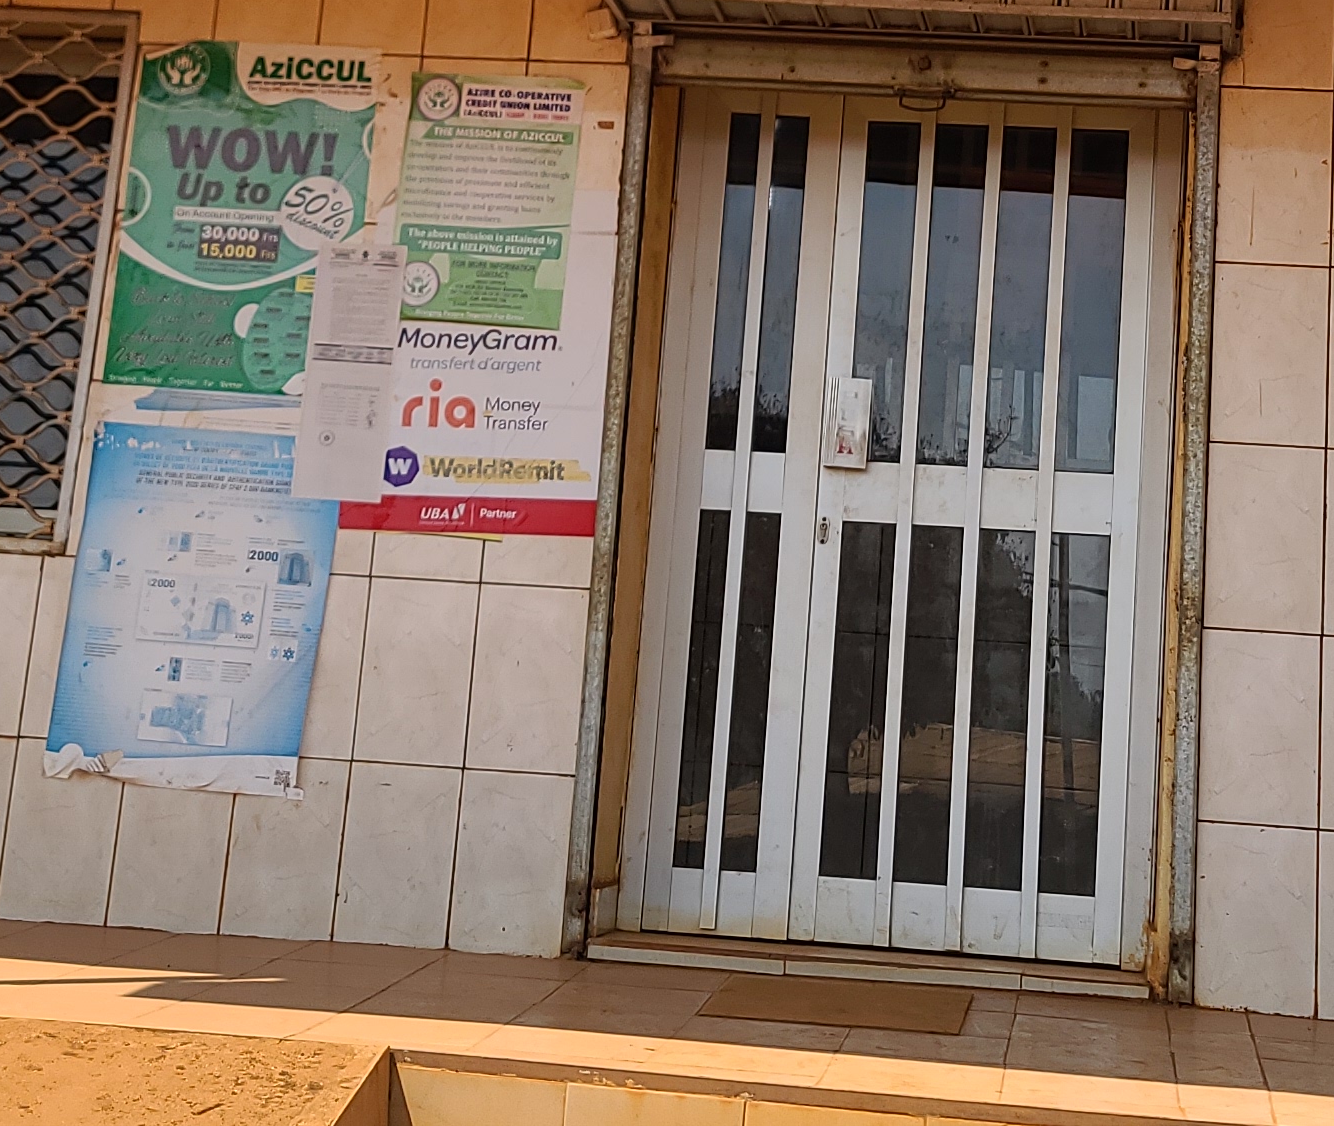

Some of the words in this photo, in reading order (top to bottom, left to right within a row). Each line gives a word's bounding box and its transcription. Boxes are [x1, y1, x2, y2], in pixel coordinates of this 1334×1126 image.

[249, 56, 372, 83] AziCCUL
[467, 87, 496, 98] AZIRE
[465, 99, 498, 108] CREDIT
[500, 100, 530, 111] UNION
[533, 102, 571, 113] LIMITED
[434, 126, 453, 137] THE
[455, 126, 501, 139] MISSION
[503, 128, 518, 140] OF
[521, 130, 566, 143] AZICCUL
[167, 124, 339, 176] WOW!
[176, 171, 225, 207] Up
[235, 175, 272, 205] to
[284, 185, 354, 228] 50%
[193, 210, 231, 219] Account
[233, 211, 275, 223] Opening
[286, 209, 341, 240] discount
[201, 225, 260, 242] 30,000
[408, 227, 426, 238] The
[427, 228, 455, 239] above
[456, 230, 494, 242] mission
[495, 231, 504, 242] is
[505, 233, 545, 245] attained
[546, 235, 559, 247] by
[200, 242, 257, 259] 15,000
[460, 241, 503, 254] HELPING
[397, 327, 558, 355] MoneyGram
[410, 356, 476, 371] transfert
[478, 357, 542, 374] d'argent
[401, 377, 477, 428] ria
[485, 397, 541, 415] Money
[483, 415, 549, 431] Transfer
[387, 457, 413, 476] W
[420, 507, 450, 520] UBA
[479, 508, 517, 520] Partner
[249, 549, 279, 562] 2000
[149, 578, 176, 588] 2000
